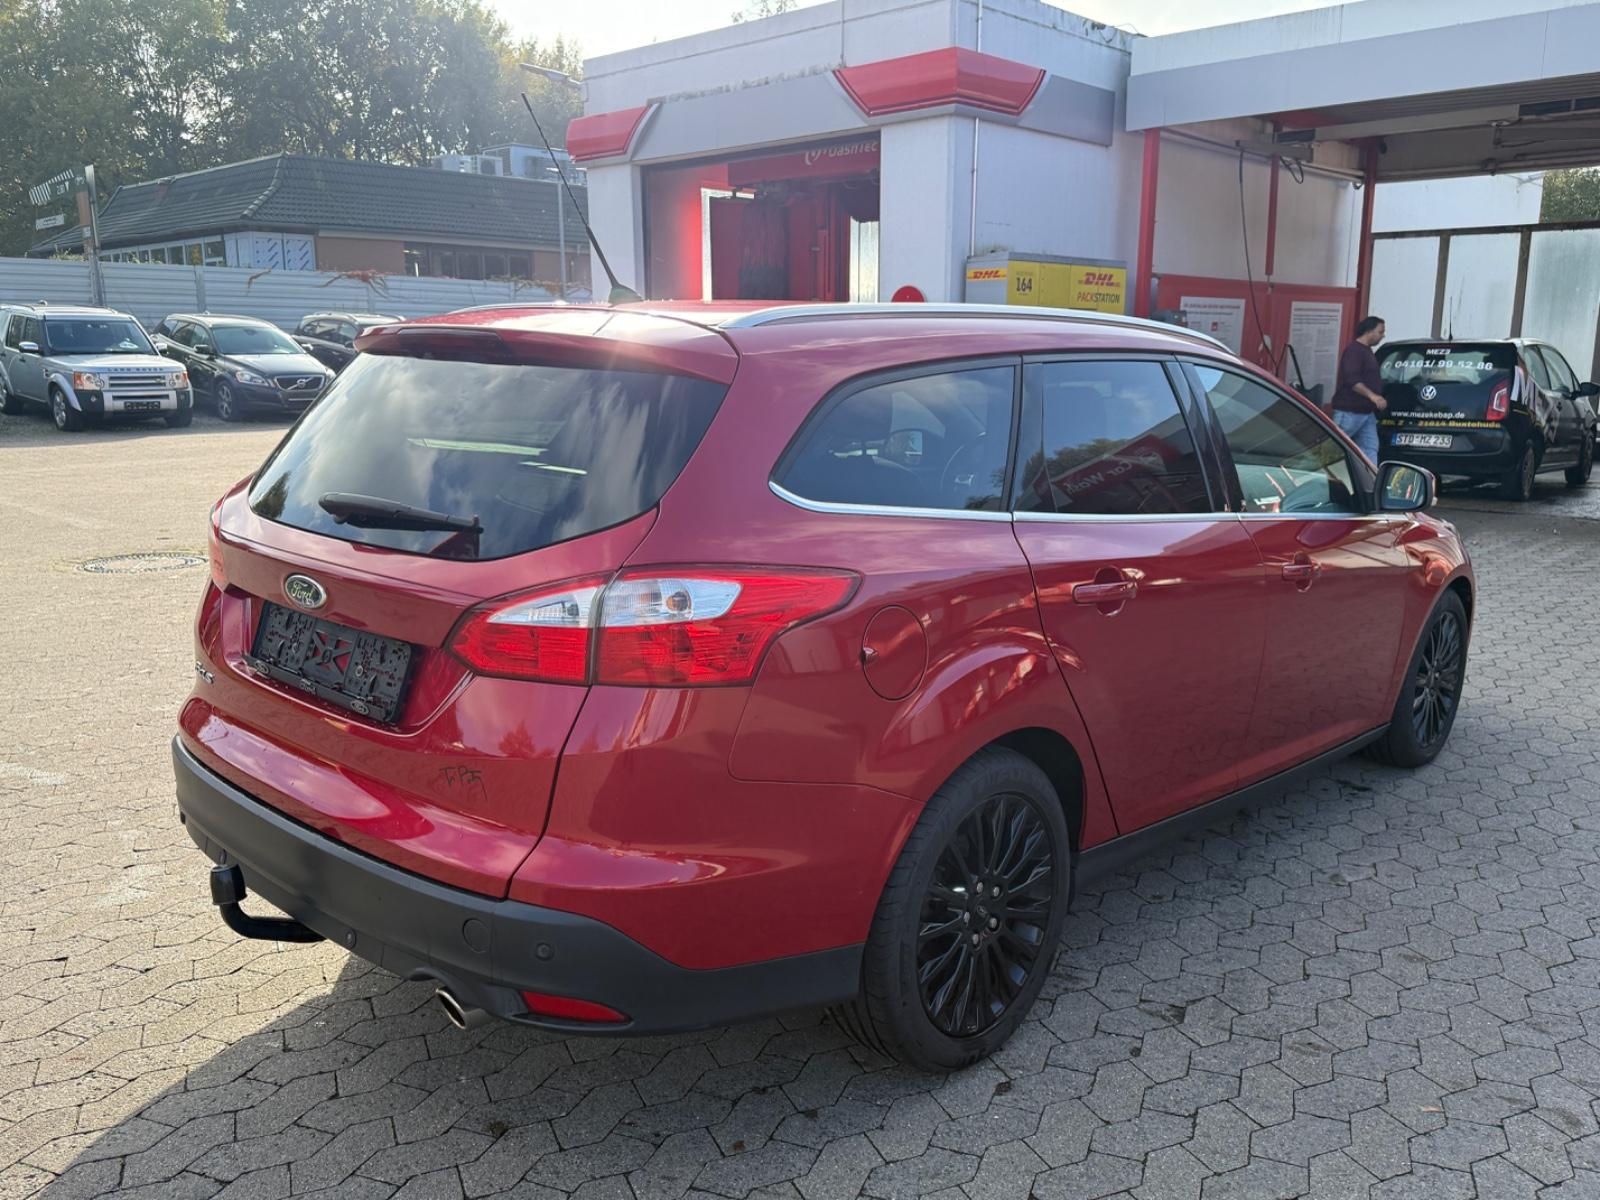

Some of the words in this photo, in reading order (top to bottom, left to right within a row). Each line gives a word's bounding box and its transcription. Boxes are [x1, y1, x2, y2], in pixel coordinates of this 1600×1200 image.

[973, 270, 1001, 279] DHL
[1084, 272, 1115, 286] DHL
[1016, 277, 1033, 292] 164
[1077, 292, 1120, 304] PACKSTATION
[1437, 360, 1453, 368] 99
[290, 581, 314, 602] Ford
